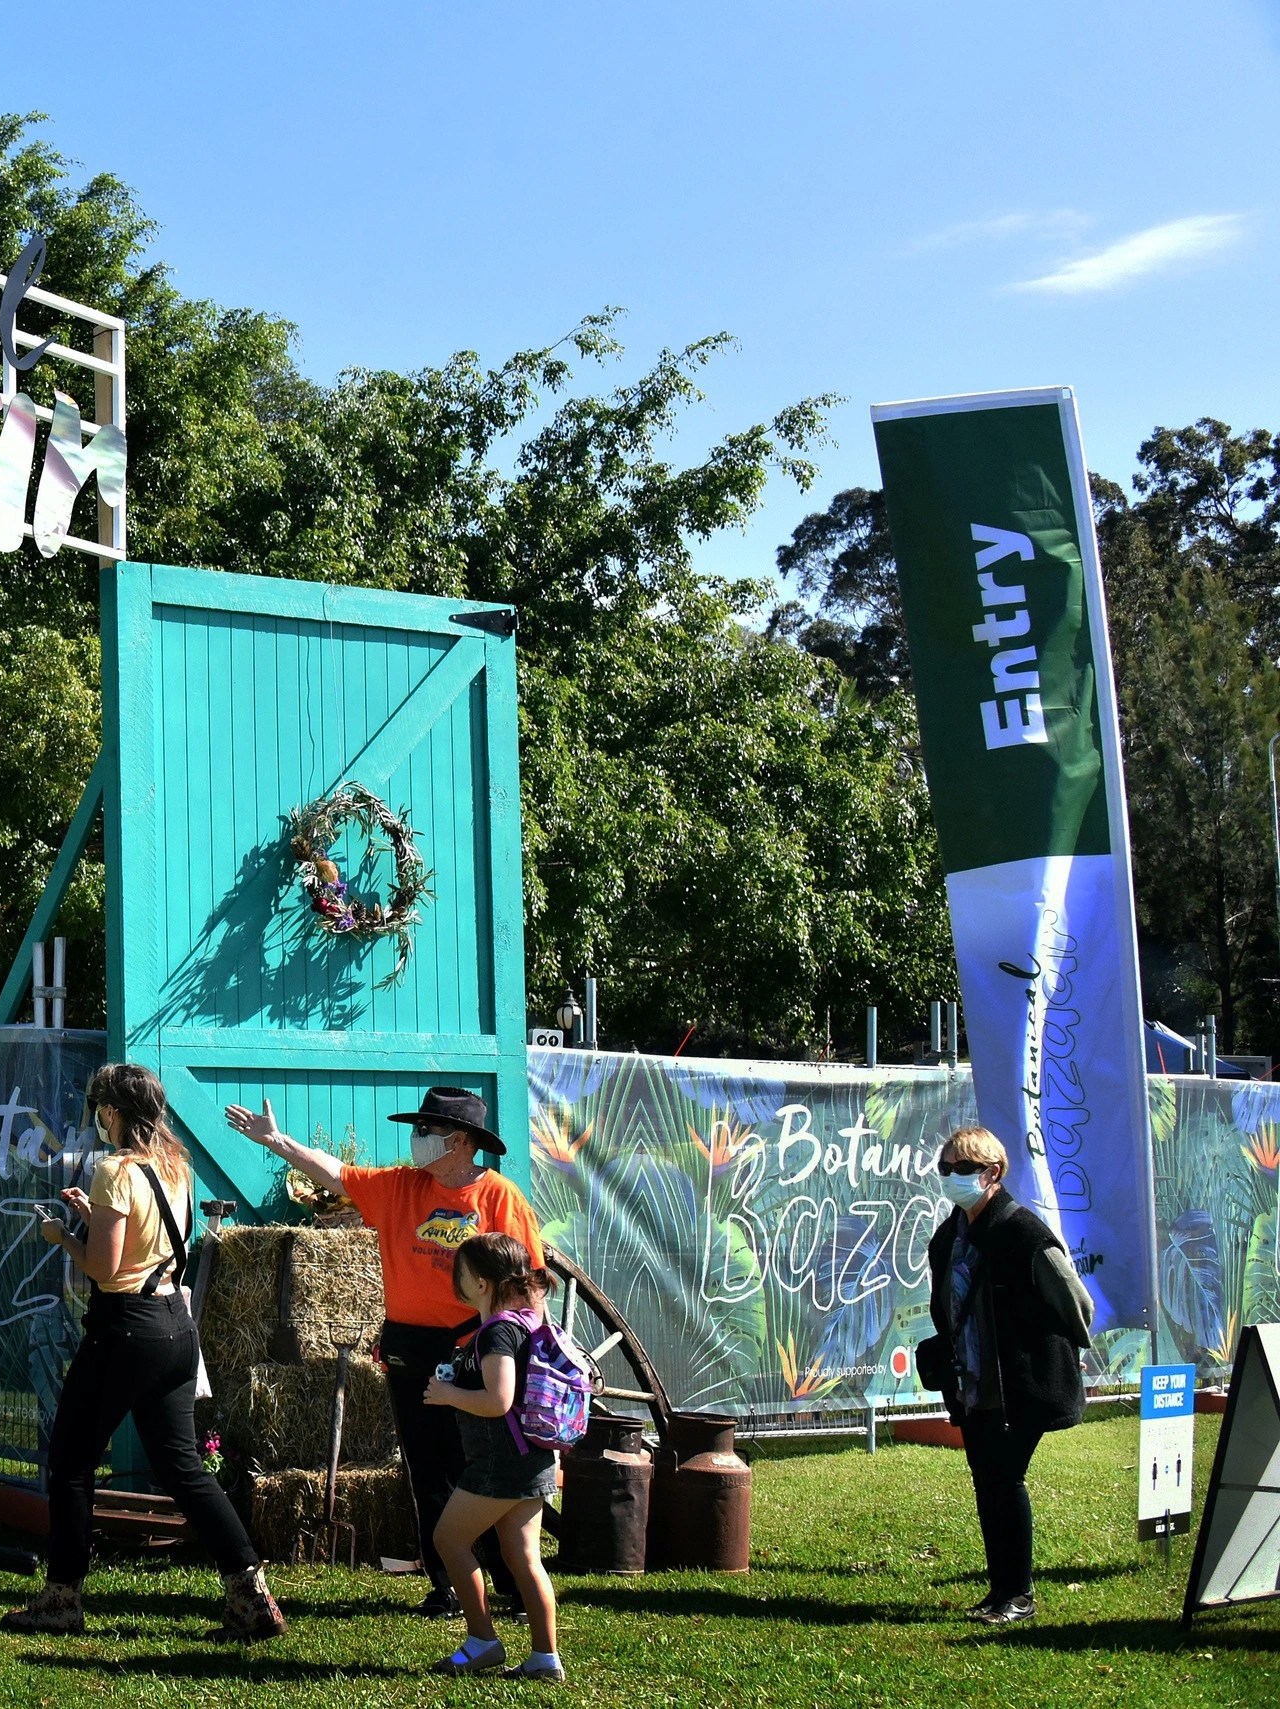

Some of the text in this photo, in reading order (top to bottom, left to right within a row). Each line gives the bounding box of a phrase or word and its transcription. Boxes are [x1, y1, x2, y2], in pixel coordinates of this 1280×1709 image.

[970, 522, 1048, 751] Entry
[999, 952, 1049, 1160] Botanical
[776, 1103, 944, 1188] Botani
[836, 1363, 878, 1378] supported
[878, 1362, 888, 1376] by
[1152, 1375, 1169, 1391] KEEP
[1153, 1392, 1184, 1409] DISTANCE
